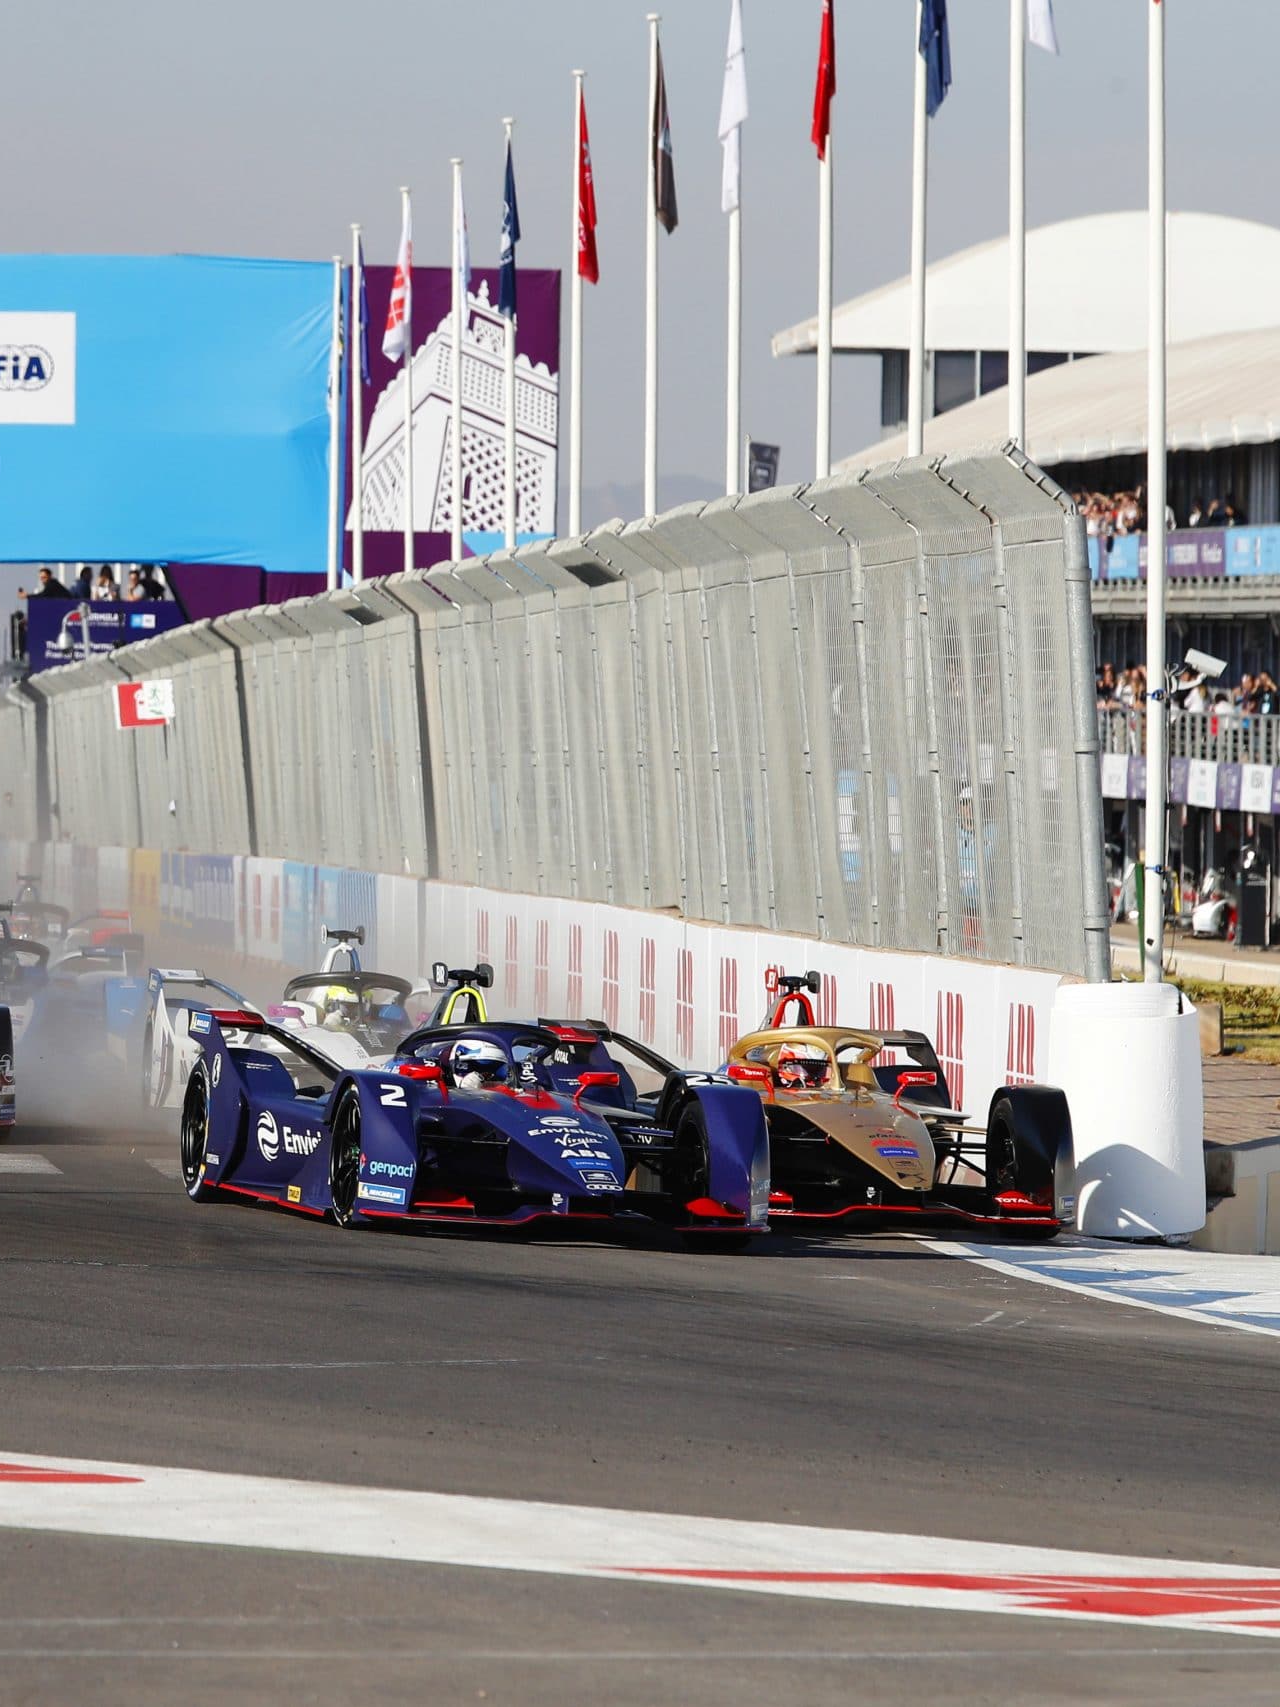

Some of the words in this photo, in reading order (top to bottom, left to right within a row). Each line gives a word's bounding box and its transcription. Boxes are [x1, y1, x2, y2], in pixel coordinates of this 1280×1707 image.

[744, 1069, 765, 1077] TOTAL
[380, 1084, 407, 1107] 2
[527, 1127, 609, 1140] Envision
[554, 1133, 603, 1149] Virgin
[369, 1160, 414, 1178] genpact
[994, 1197, 1034, 1205] TOTAL
